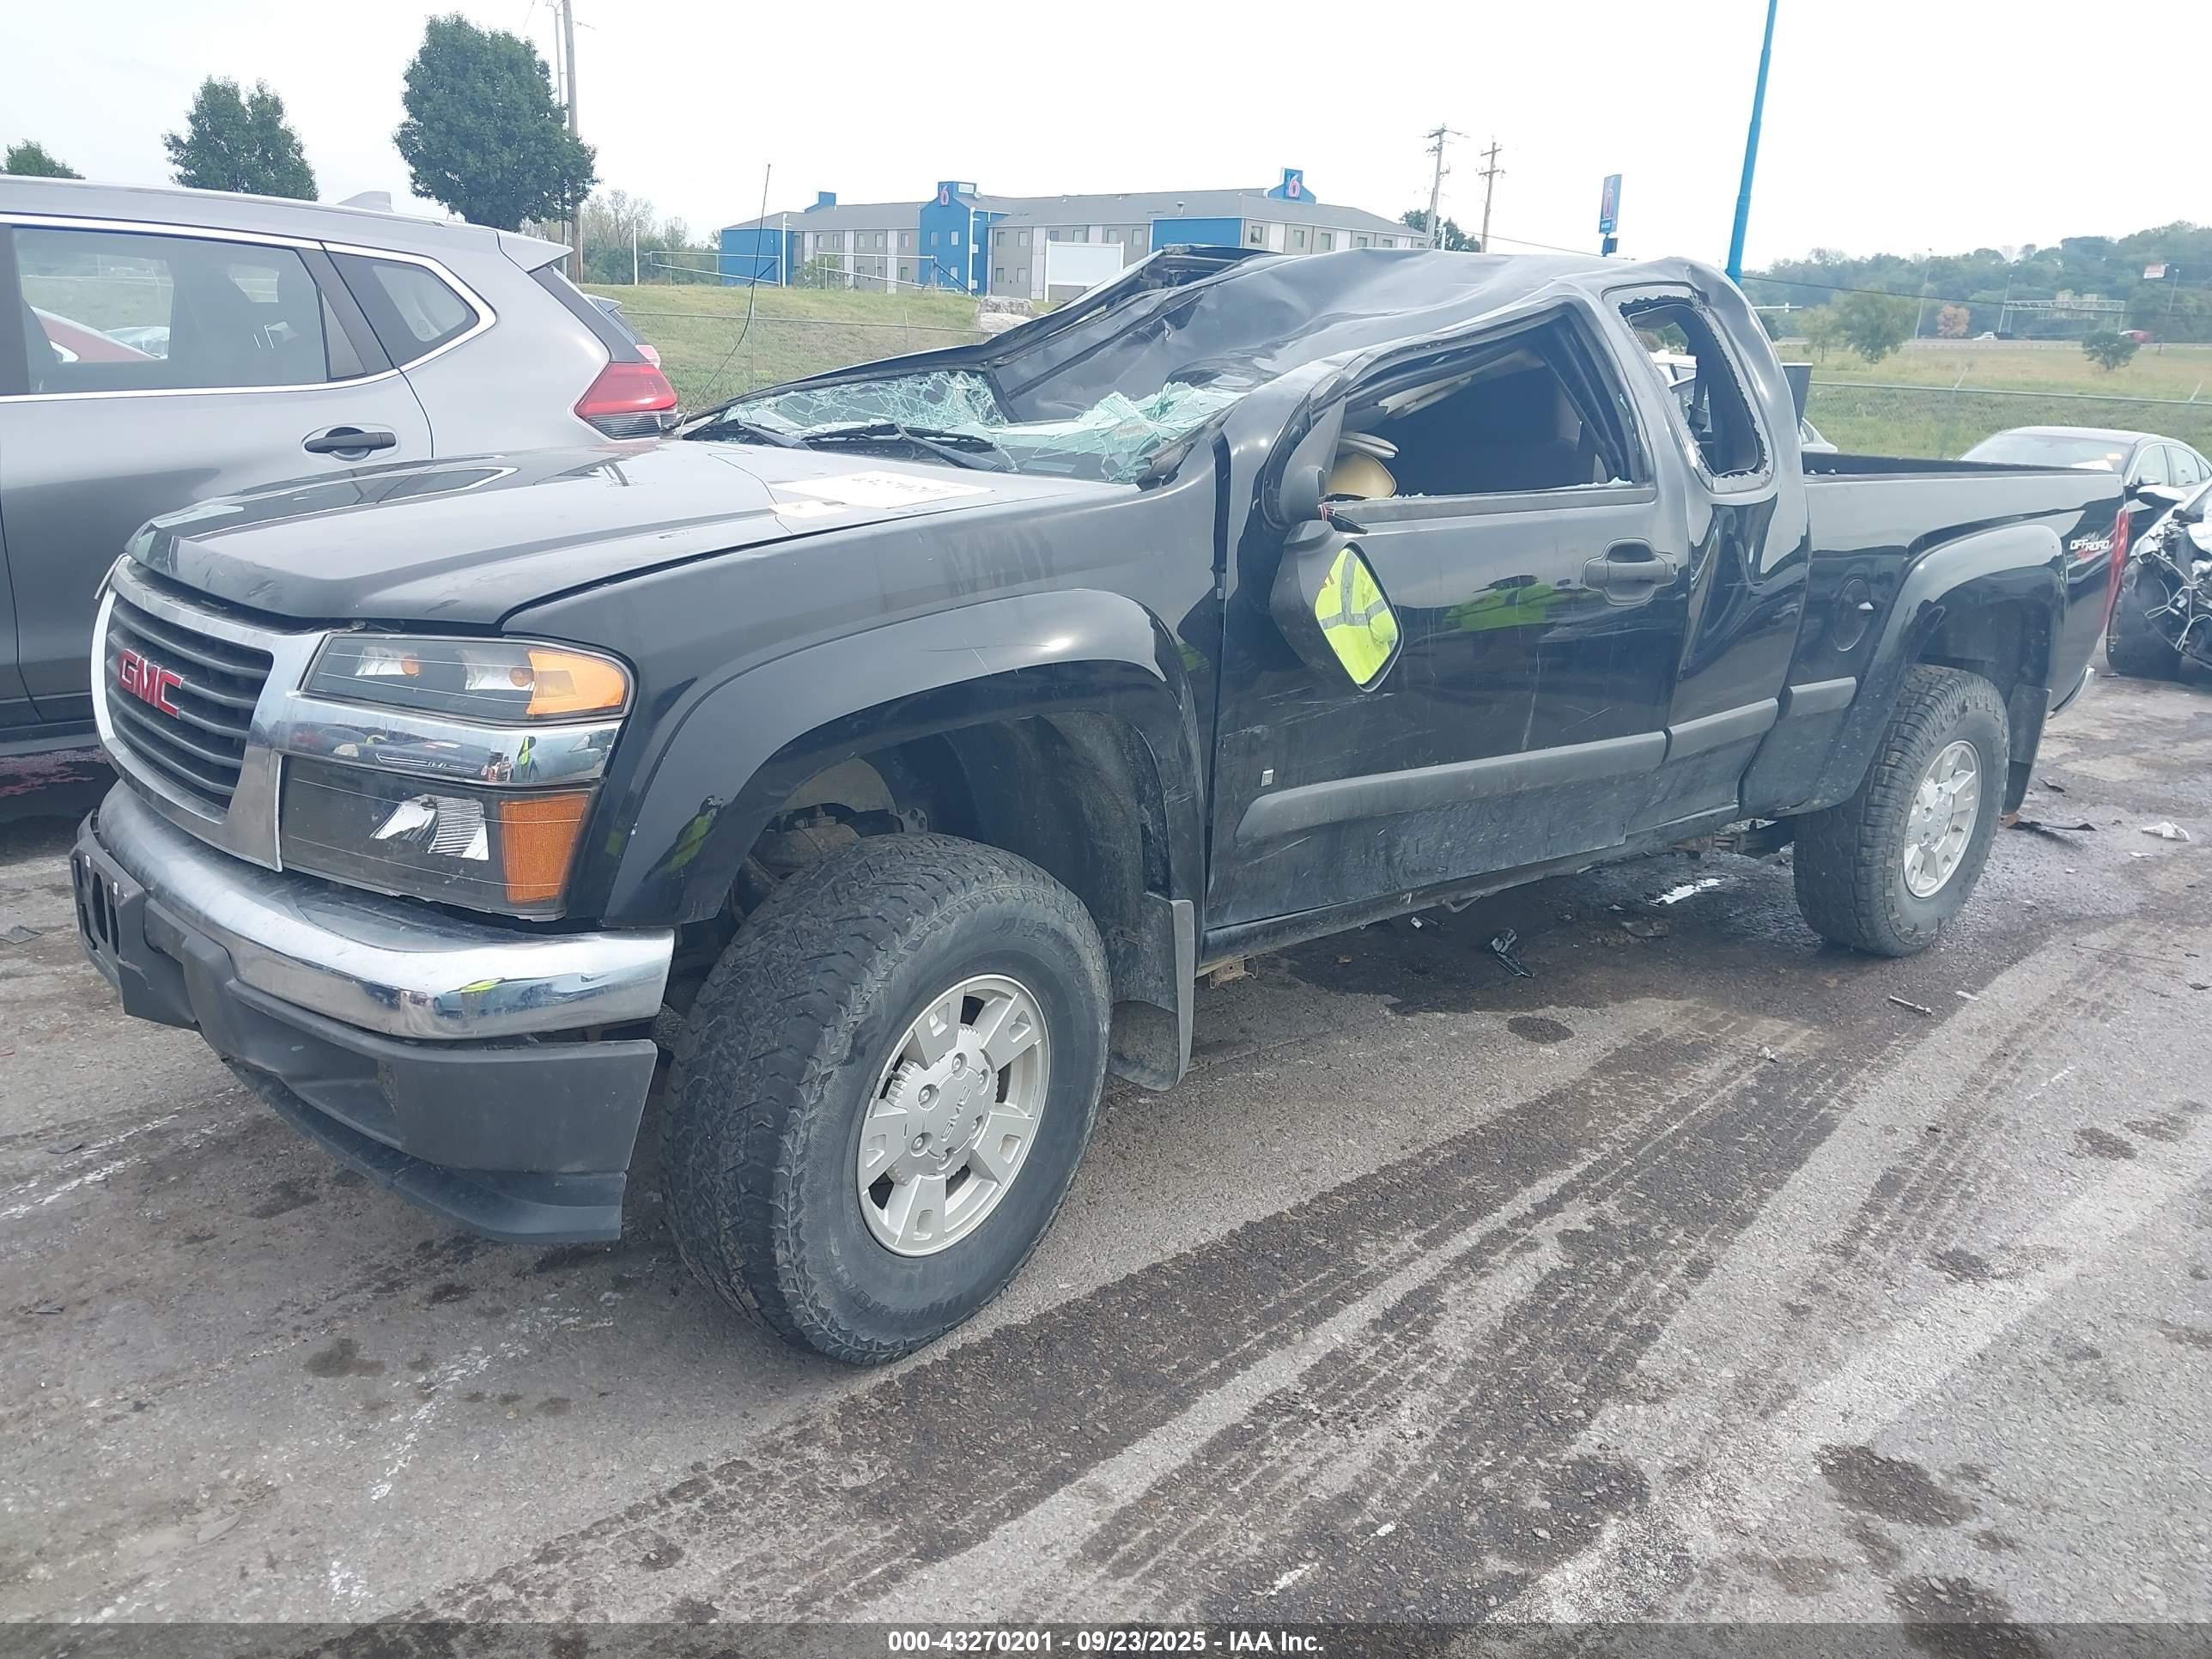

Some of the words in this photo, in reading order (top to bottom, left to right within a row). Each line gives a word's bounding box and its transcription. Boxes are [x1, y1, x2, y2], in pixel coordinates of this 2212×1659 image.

[1288, 174, 1300, 198] 6
[119, 648, 184, 720] GMC
[939, 1085, 972, 1143] GMC
